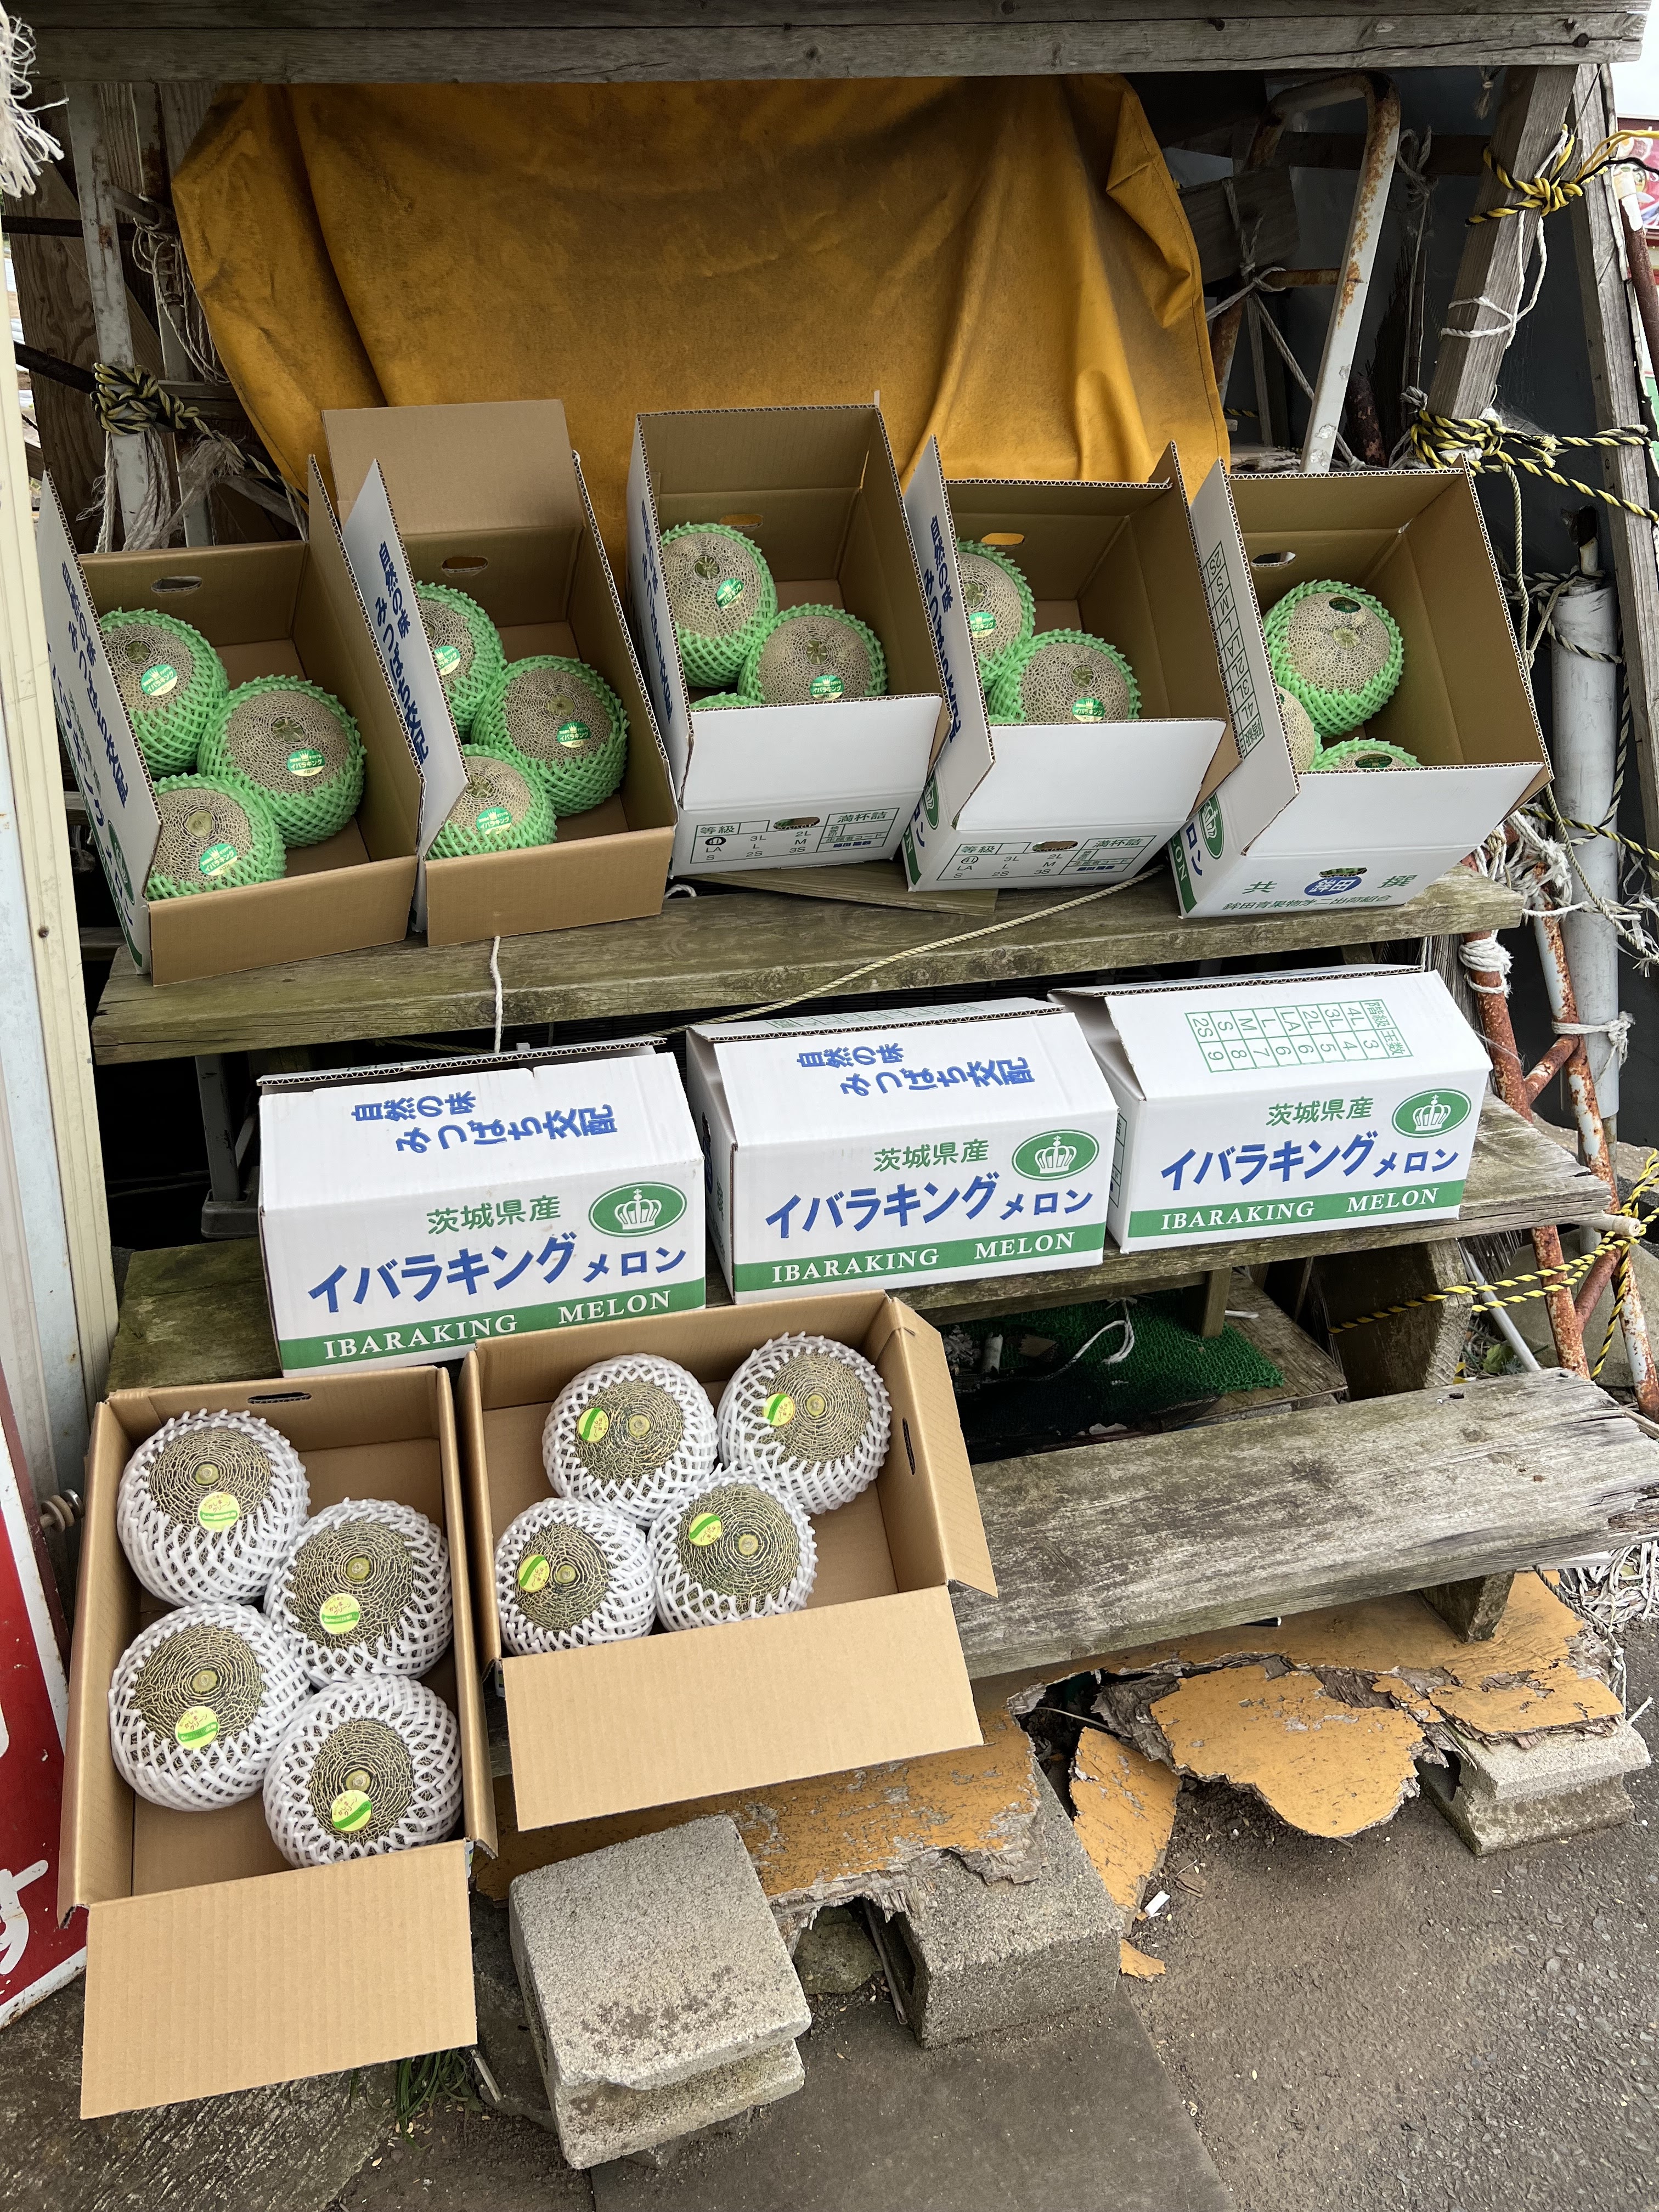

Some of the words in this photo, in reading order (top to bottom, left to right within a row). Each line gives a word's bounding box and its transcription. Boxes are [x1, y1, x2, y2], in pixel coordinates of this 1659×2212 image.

[930, 515, 953, 614] 自然の味
[1210, 552, 1222, 574] 2S
[379, 540, 411, 639] 自然の味
[721, 583, 741, 605] イバラキング
[1215, 577, 1223, 593] S
[1219, 596, 1229, 615] M
[1225, 618, 1232, 631] L
[1226, 635, 1240, 657] LA
[1232, 658, 1244, 679] 2L
[147, 670, 174, 692] イバラキング
[812, 685, 842, 693] イバラキング
[1236, 680, 1249, 700] 3L
[1242, 701, 1254, 720] 4L
[560, 732, 589, 741] イバラキング
[291, 759, 322, 770] イバラキング
[480, 816, 510, 828] イバラキング
[700, 825, 735, 834] 等級
[914, 803, 925, 848] ロン
[1186, 822, 1203, 876] ロン
[205, 849, 234, 871] イバラキング
[1242, 881, 1278, 894] 共
[1238, 1018, 1257, 1031] M
[1261, 1018, 1276, 1028] L
[1280, 1011, 1300, 1031] LA
[1304, 1011, 1322, 1030] 2L
[1325, 1008, 1344, 1028] 3L
[1347, 1007, 1365, 1026] 4L
[1364, 1001, 1390, 1028] 階級
[1193, 1018, 1214, 1038] 2S
[1217, 1021, 1234, 1031] S
[1252, 1047, 1271, 1057] 7
[1276, 1046, 1291, 1056] 6
[1298, 1045, 1314, 1054] 6
[1321, 1043, 1337, 1053] 5
[1342, 1041, 1358, 1051] 4
[1363, 1040, 1379, 1049] 3
[1380, 1030, 1406, 1056] 玉数
[797, 1043, 904, 1069] 自然の味
[1208, 1051, 1224, 1060] 9
[1231, 1049, 1247, 1059] 8
[840, 1057, 1035, 1097] みつばち交配
[351, 1091, 476, 1122] 自然の味
[1267, 1097, 1373, 1126] 茨城県産
[396, 1105, 617, 1153] みつばち交配
[874, 1139, 989, 1171] 茨城県産
[1161, 1131, 1378, 1191] イバラキング
[1374, 1150, 1458, 1177] メロン
[427, 1195, 560, 1234] 茨城県産
[766, 1172, 999, 1239] イバラキング
[1000, 1190, 1092, 1220] メロン
[1161, 1201, 1314, 1230] IBARAKING
[1346, 1188, 1439, 1212] MELON
[772, 1249, 939, 1283] IBARAKING
[974, 1232, 1075, 1259] MELON
[308, 1232, 576, 1313] イバラキング
[584, 1248, 686, 1283] メロン
[324, 1314, 518, 1359] IBARAKING
[558, 1290, 670, 1324] MELON
